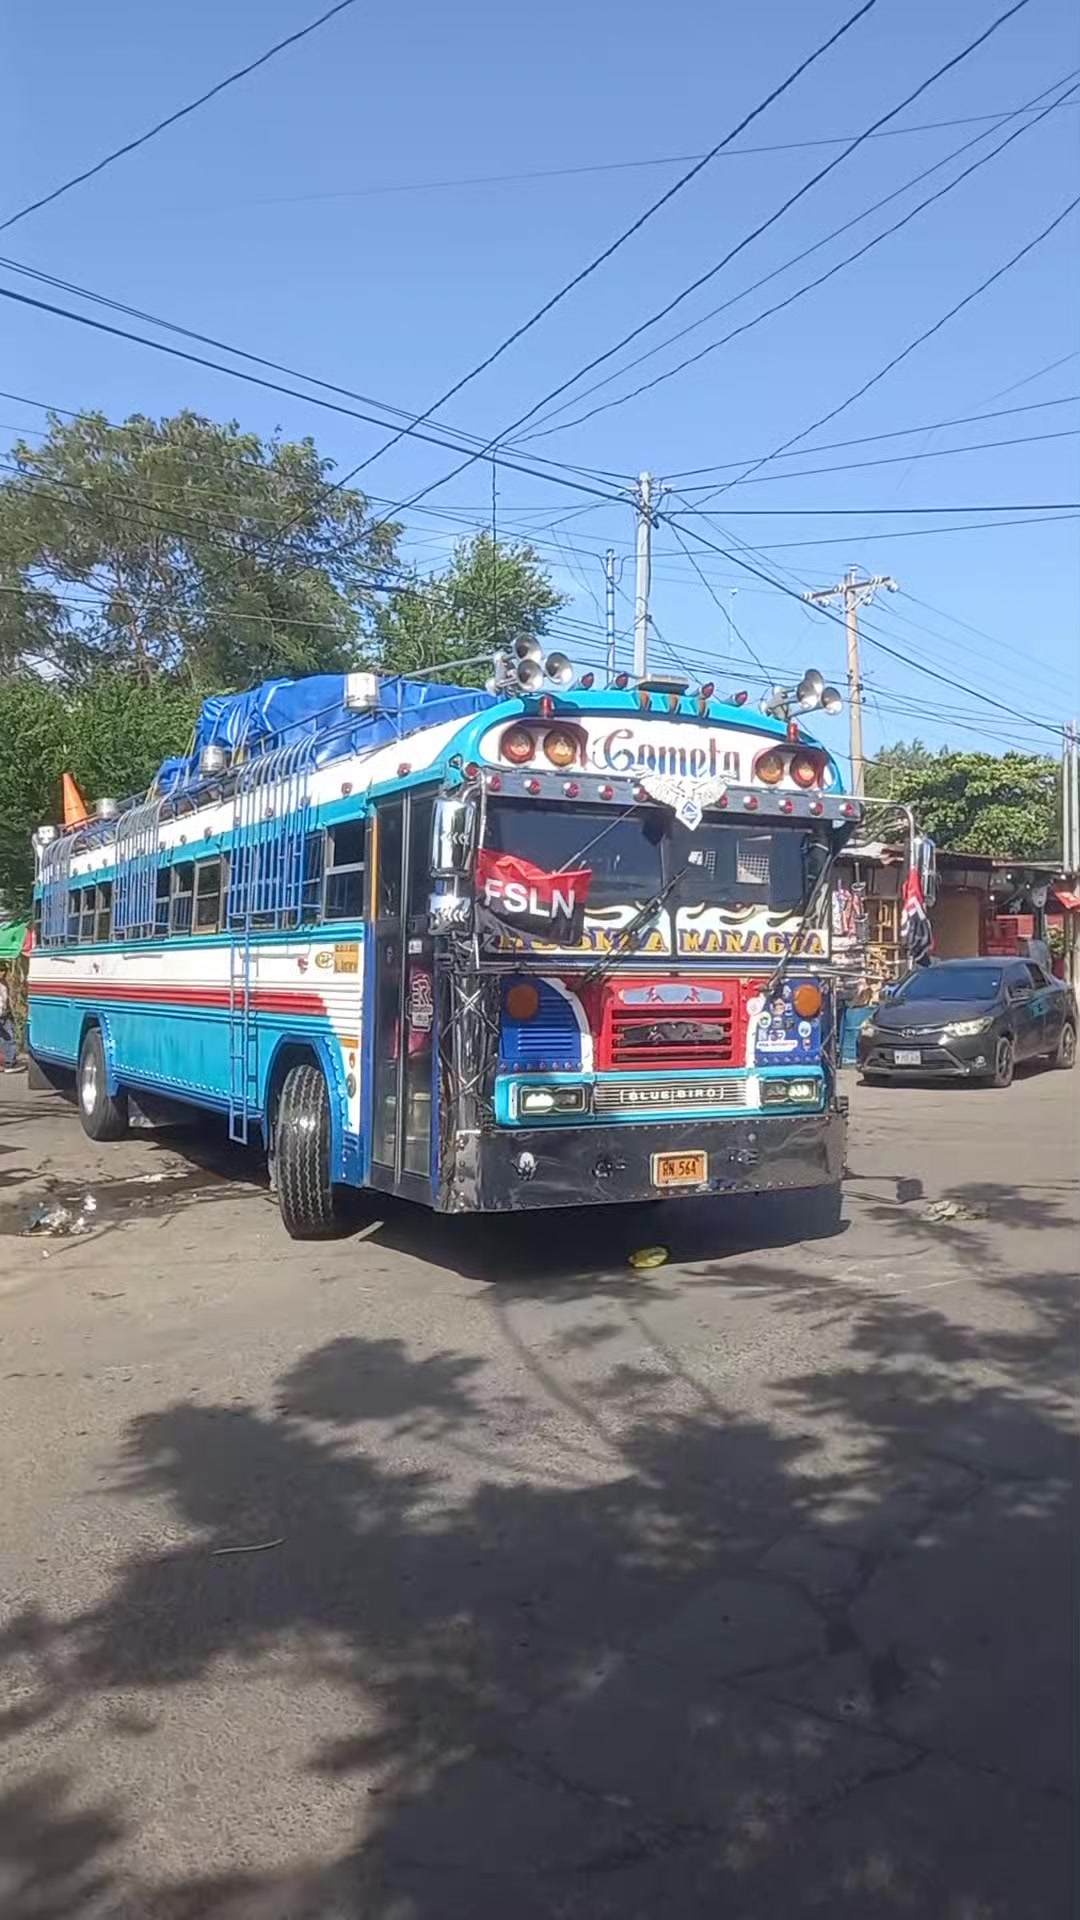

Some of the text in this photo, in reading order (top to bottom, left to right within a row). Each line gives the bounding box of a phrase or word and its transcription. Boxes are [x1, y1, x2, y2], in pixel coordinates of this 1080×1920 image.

[484, 878, 575, 919] FSLN
[678, 929, 825, 954] MANAGUA
[628, 1090, 670, 1101] BLUE
[678, 1160, 696, 1178] 564
